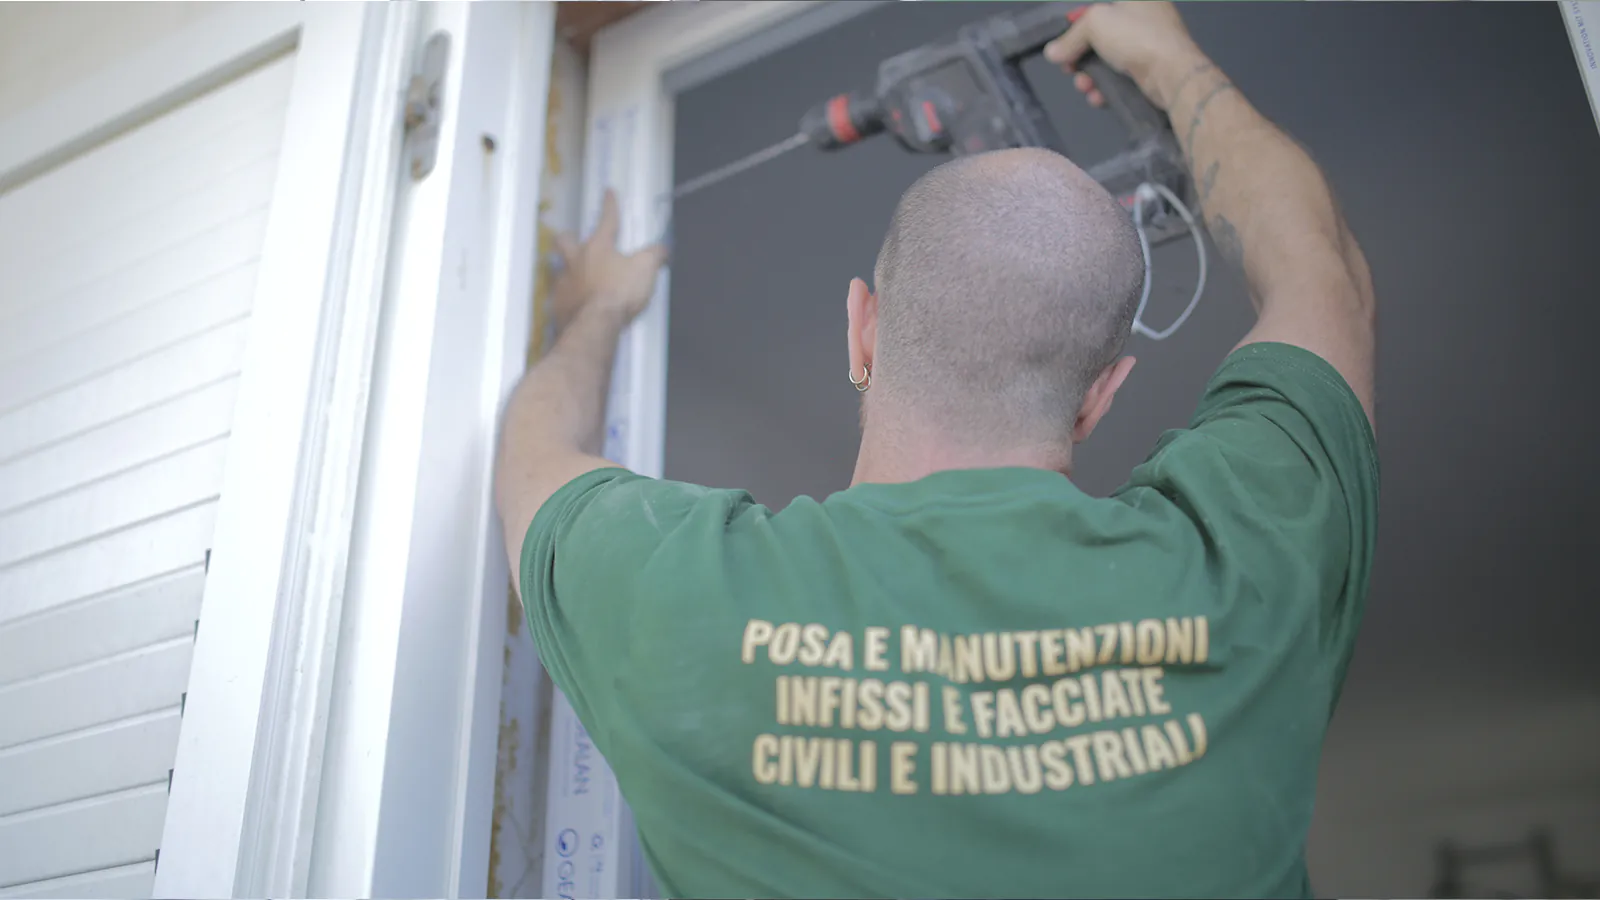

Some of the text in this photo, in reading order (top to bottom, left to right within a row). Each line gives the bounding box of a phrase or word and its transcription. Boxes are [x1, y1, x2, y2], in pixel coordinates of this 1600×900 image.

[1580, 28, 1597, 69] INNOVATION
[742, 618, 854, 671] POSA
[864, 626, 889, 671] E
[776, 667, 1172, 738] INFISSI E FACCIATE
[753, 734, 877, 793] CIVILI
[891, 741, 918, 795] E
